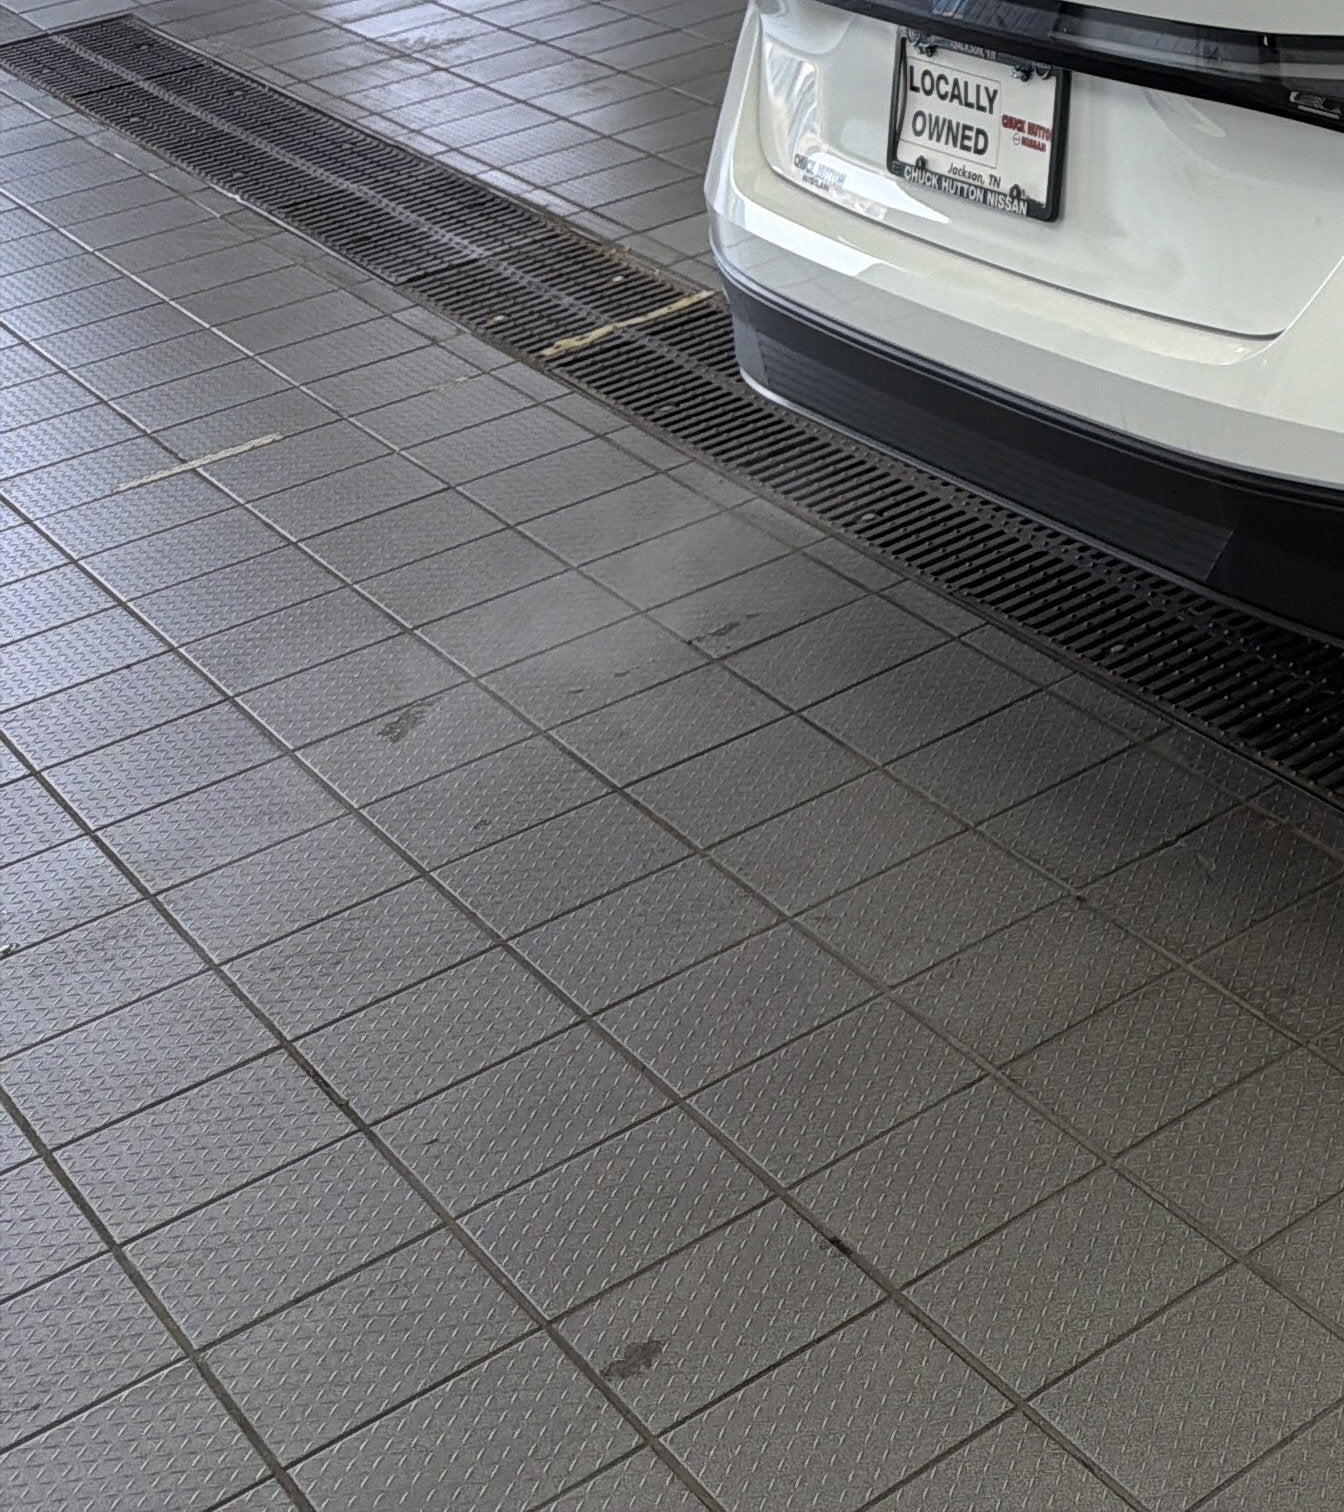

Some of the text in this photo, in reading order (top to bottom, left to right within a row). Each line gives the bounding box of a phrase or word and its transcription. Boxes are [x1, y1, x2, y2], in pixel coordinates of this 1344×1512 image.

[909, 65, 999, 115] LOCALLY
[911, 110, 989, 156] OWNED
[1001, 114, 1026, 133] CHUCK
[903, 166, 1029, 217] CHUCK HUTTON NISSAN
[948, 162, 1002, 189] Jackson, TN
